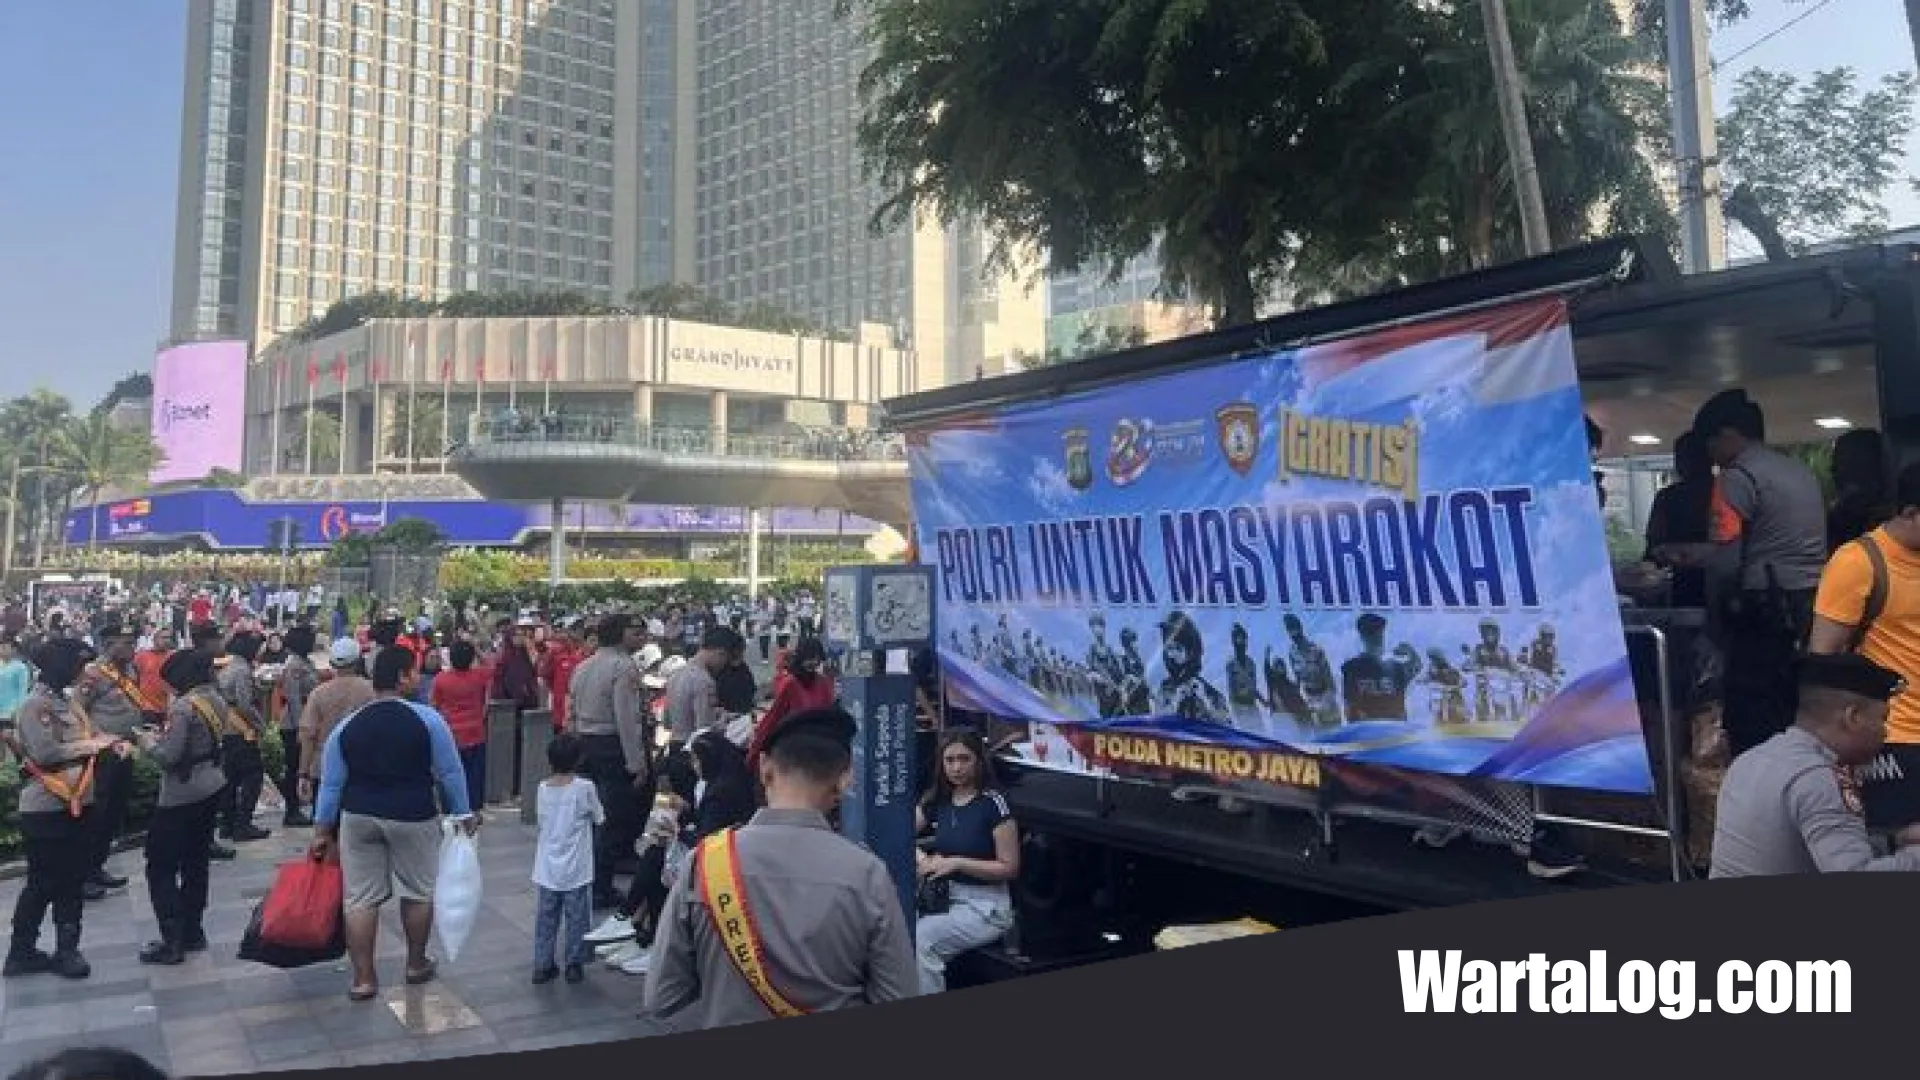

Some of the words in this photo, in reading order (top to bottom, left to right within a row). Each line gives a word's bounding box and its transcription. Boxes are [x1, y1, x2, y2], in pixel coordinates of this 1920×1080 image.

[670, 347, 733, 366] GRAND
[739, 354, 794, 374] HYATT
[936, 525, 1024, 604] POLRI
[1028, 516, 1157, 604] UNTUK
[1159, 486, 1540, 608] MASYARAKAT
[1093, 732, 1160, 766] POLDA
[1165, 741, 1249, 775] METRO
[1256, 751, 1320, 788] JAYA
